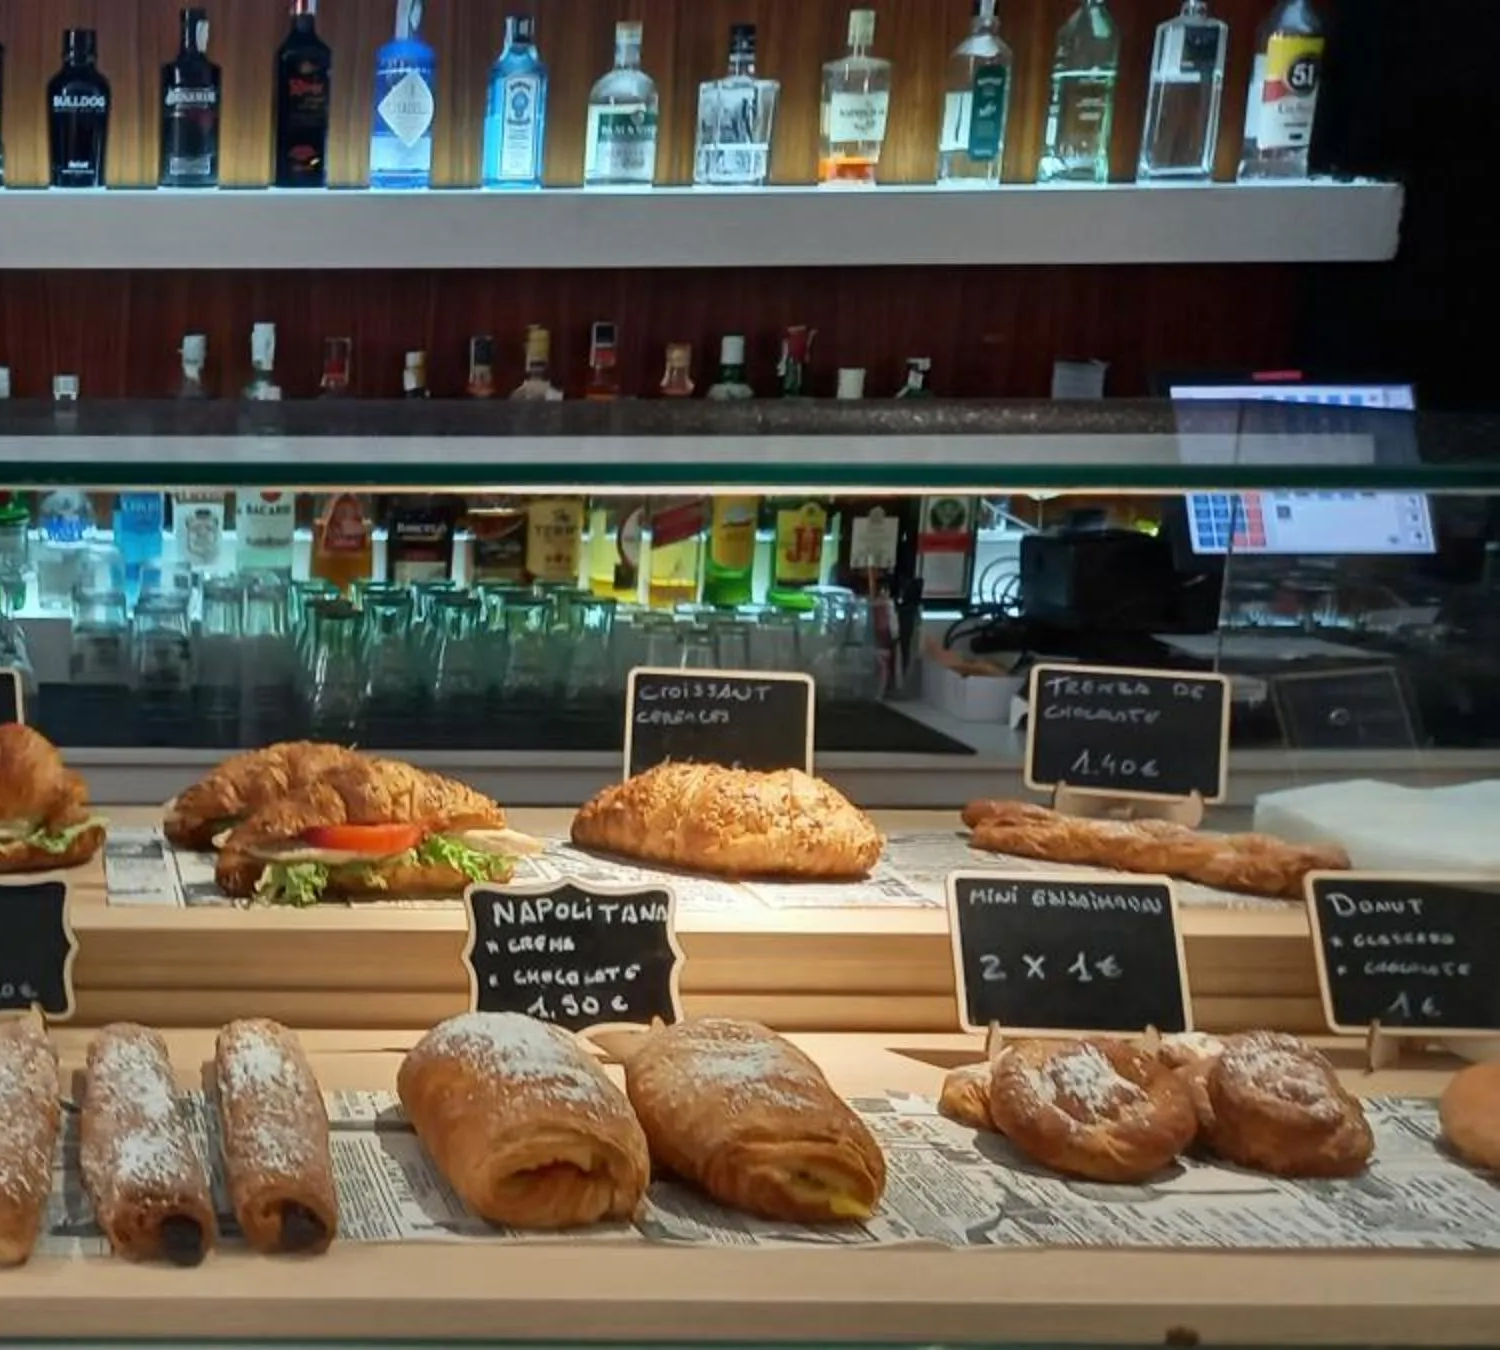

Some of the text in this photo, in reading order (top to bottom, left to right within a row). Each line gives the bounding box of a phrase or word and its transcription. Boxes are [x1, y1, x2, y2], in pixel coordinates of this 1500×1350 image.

[1291, 62, 1314, 87] 51
[53, 95, 105, 107] BULLDOG
[1325, 892, 1424, 917] DONUT
[507, 934, 576, 954] CREMA
[979, 954, 1007, 982] 2
